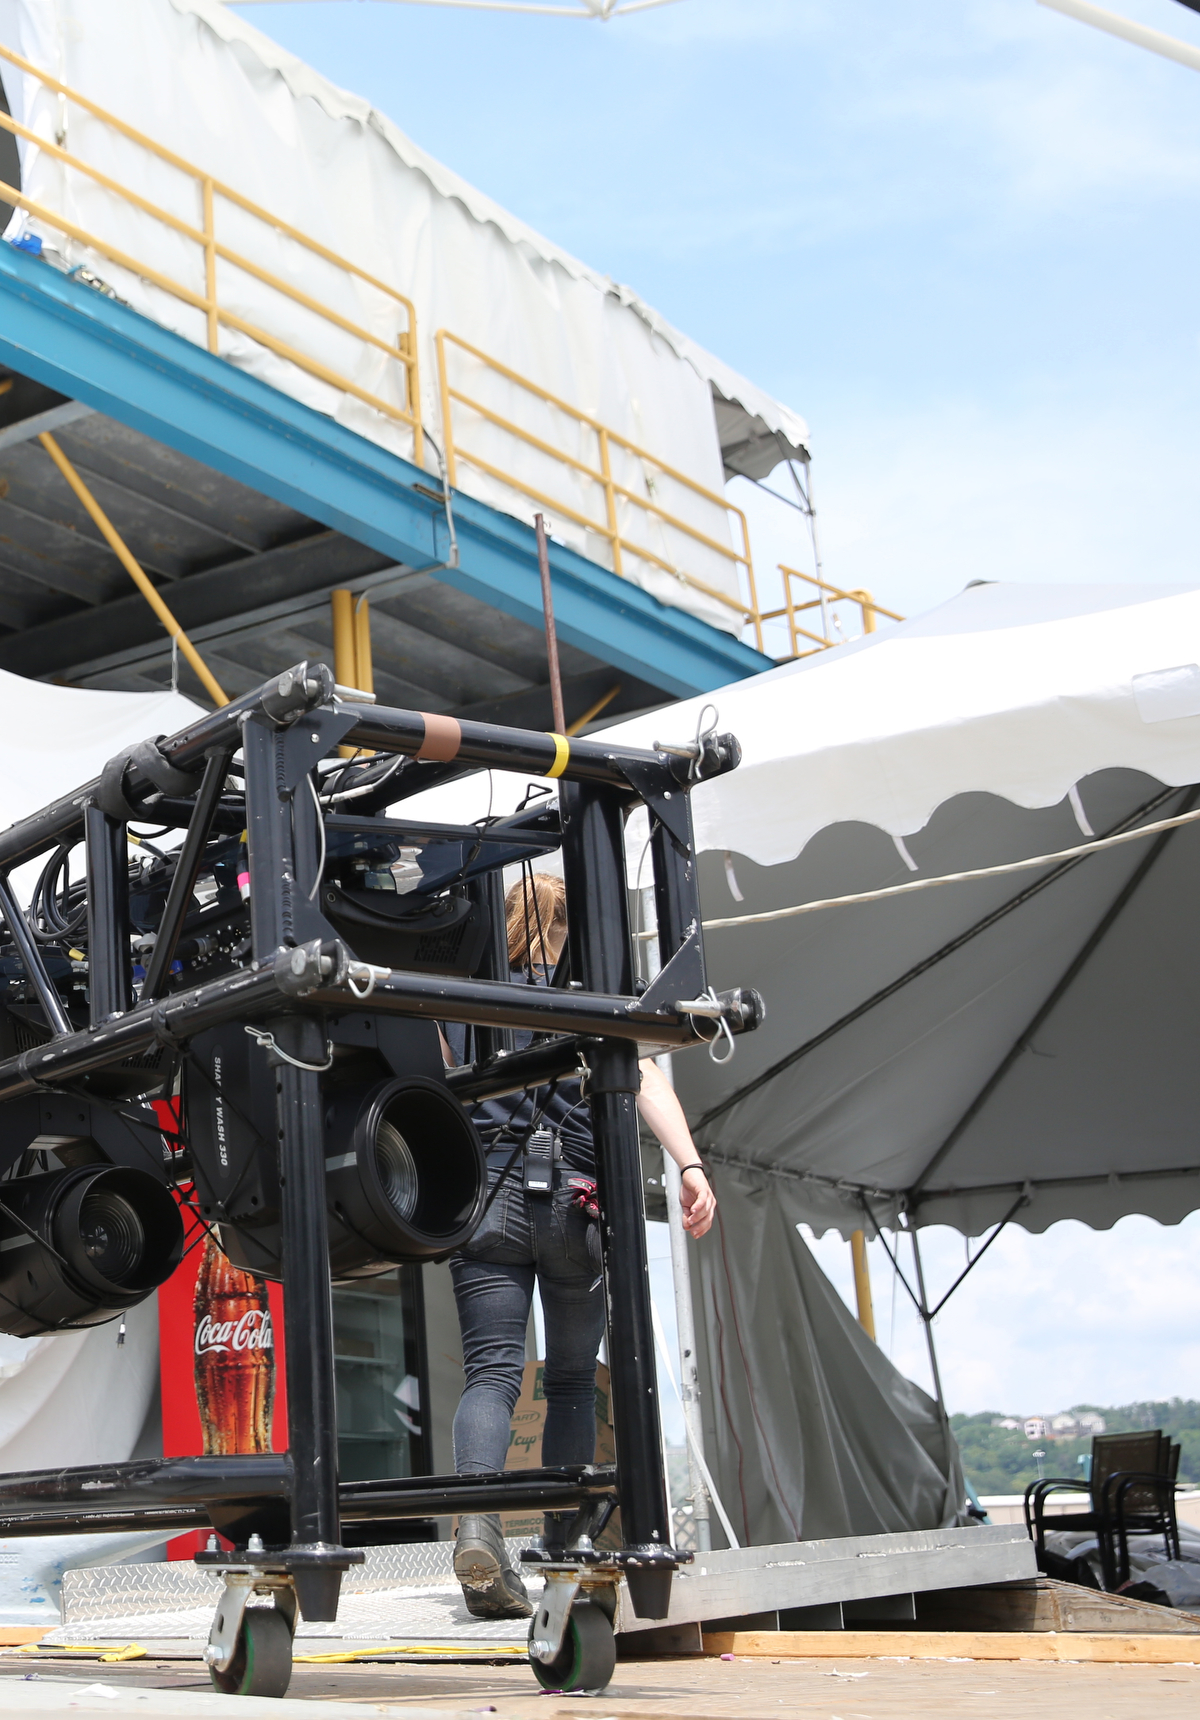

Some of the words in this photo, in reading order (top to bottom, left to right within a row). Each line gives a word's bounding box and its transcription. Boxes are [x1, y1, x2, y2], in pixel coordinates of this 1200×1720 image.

[214, 1056, 222, 1104] SHAY
[216, 1107, 225, 1142] WASH
[219, 1144, 228, 1166] 330
[195, 1310, 273, 1355] Coca-Cola
